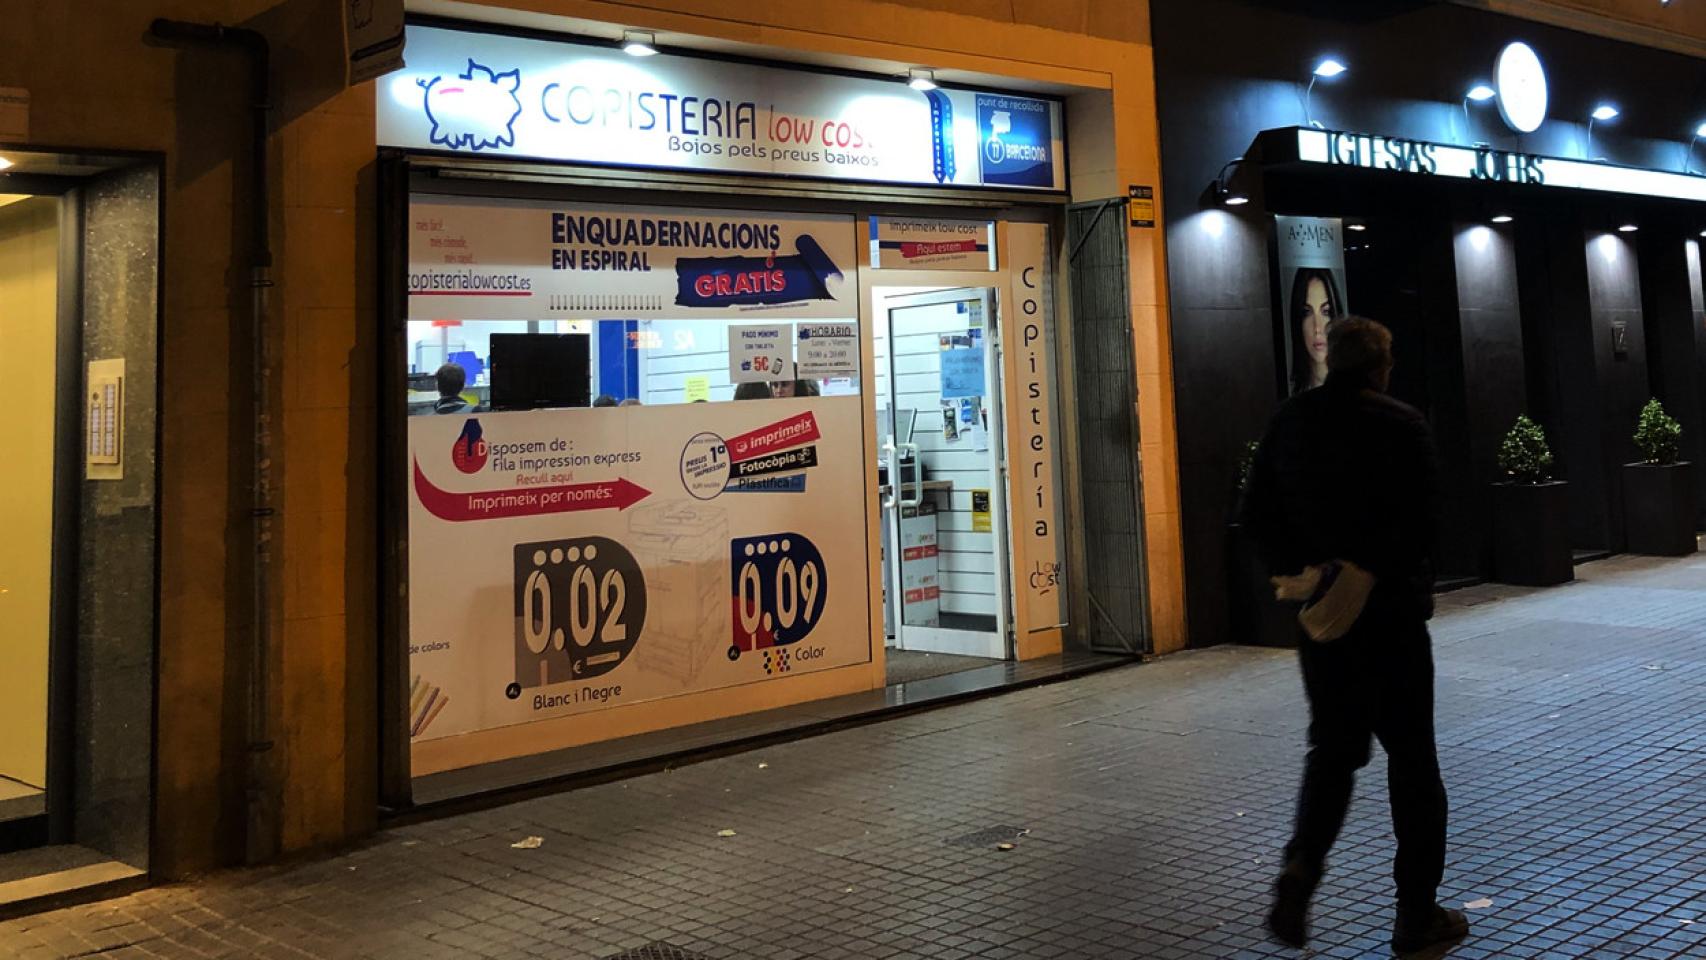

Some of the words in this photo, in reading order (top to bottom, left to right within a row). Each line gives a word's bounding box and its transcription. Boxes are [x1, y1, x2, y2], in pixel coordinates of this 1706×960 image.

[977, 97, 996, 107] punt
[997, 98, 1008, 108] de
[541, 82, 757, 140] COPISTERIA
[767, 105, 814, 142] low
[821, 115, 876, 149] cos
[668, 135, 723, 155] Bojos
[728, 143, 767, 158] pels
[771, 149, 820, 162] preus
[824, 149, 879, 167] baixos
[1005, 143, 1046, 162] BARCELONA
[551, 213, 780, 250] ENQUADERNACIONS
[889, 221, 937, 235] imprimeix
[939, 222, 956, 234] low
[957, 223, 978, 235] cost
[552, 249, 577, 270] EN
[581, 250, 651, 272] ESPIRAL
[695, 269, 787, 297] GRATIS
[741, 330, 756, 339] PAGO
[811, 326, 851, 337] HORARIO
[750, 419, 812, 449] imprimeix
[478, 441, 546, 457] Disposem
[550, 438, 566, 452] de
[493, 457, 516, 472] Fila
[519, 453, 590, 471] impression
[594, 451, 641, 467] express
[739, 452, 796, 474] Fotocòpia
[516, 473, 549, 486] Recull
[469, 492, 538, 511] Imprimeix
[541, 493, 565, 507] per
[738, 556, 819, 634] 0.09
[524, 564, 627, 654] 0.02
[421, 640, 450, 653] colors
[795, 646, 826, 662] Color
[533, 692, 571, 710] Blanc
[584, 684, 622, 703] Negre
